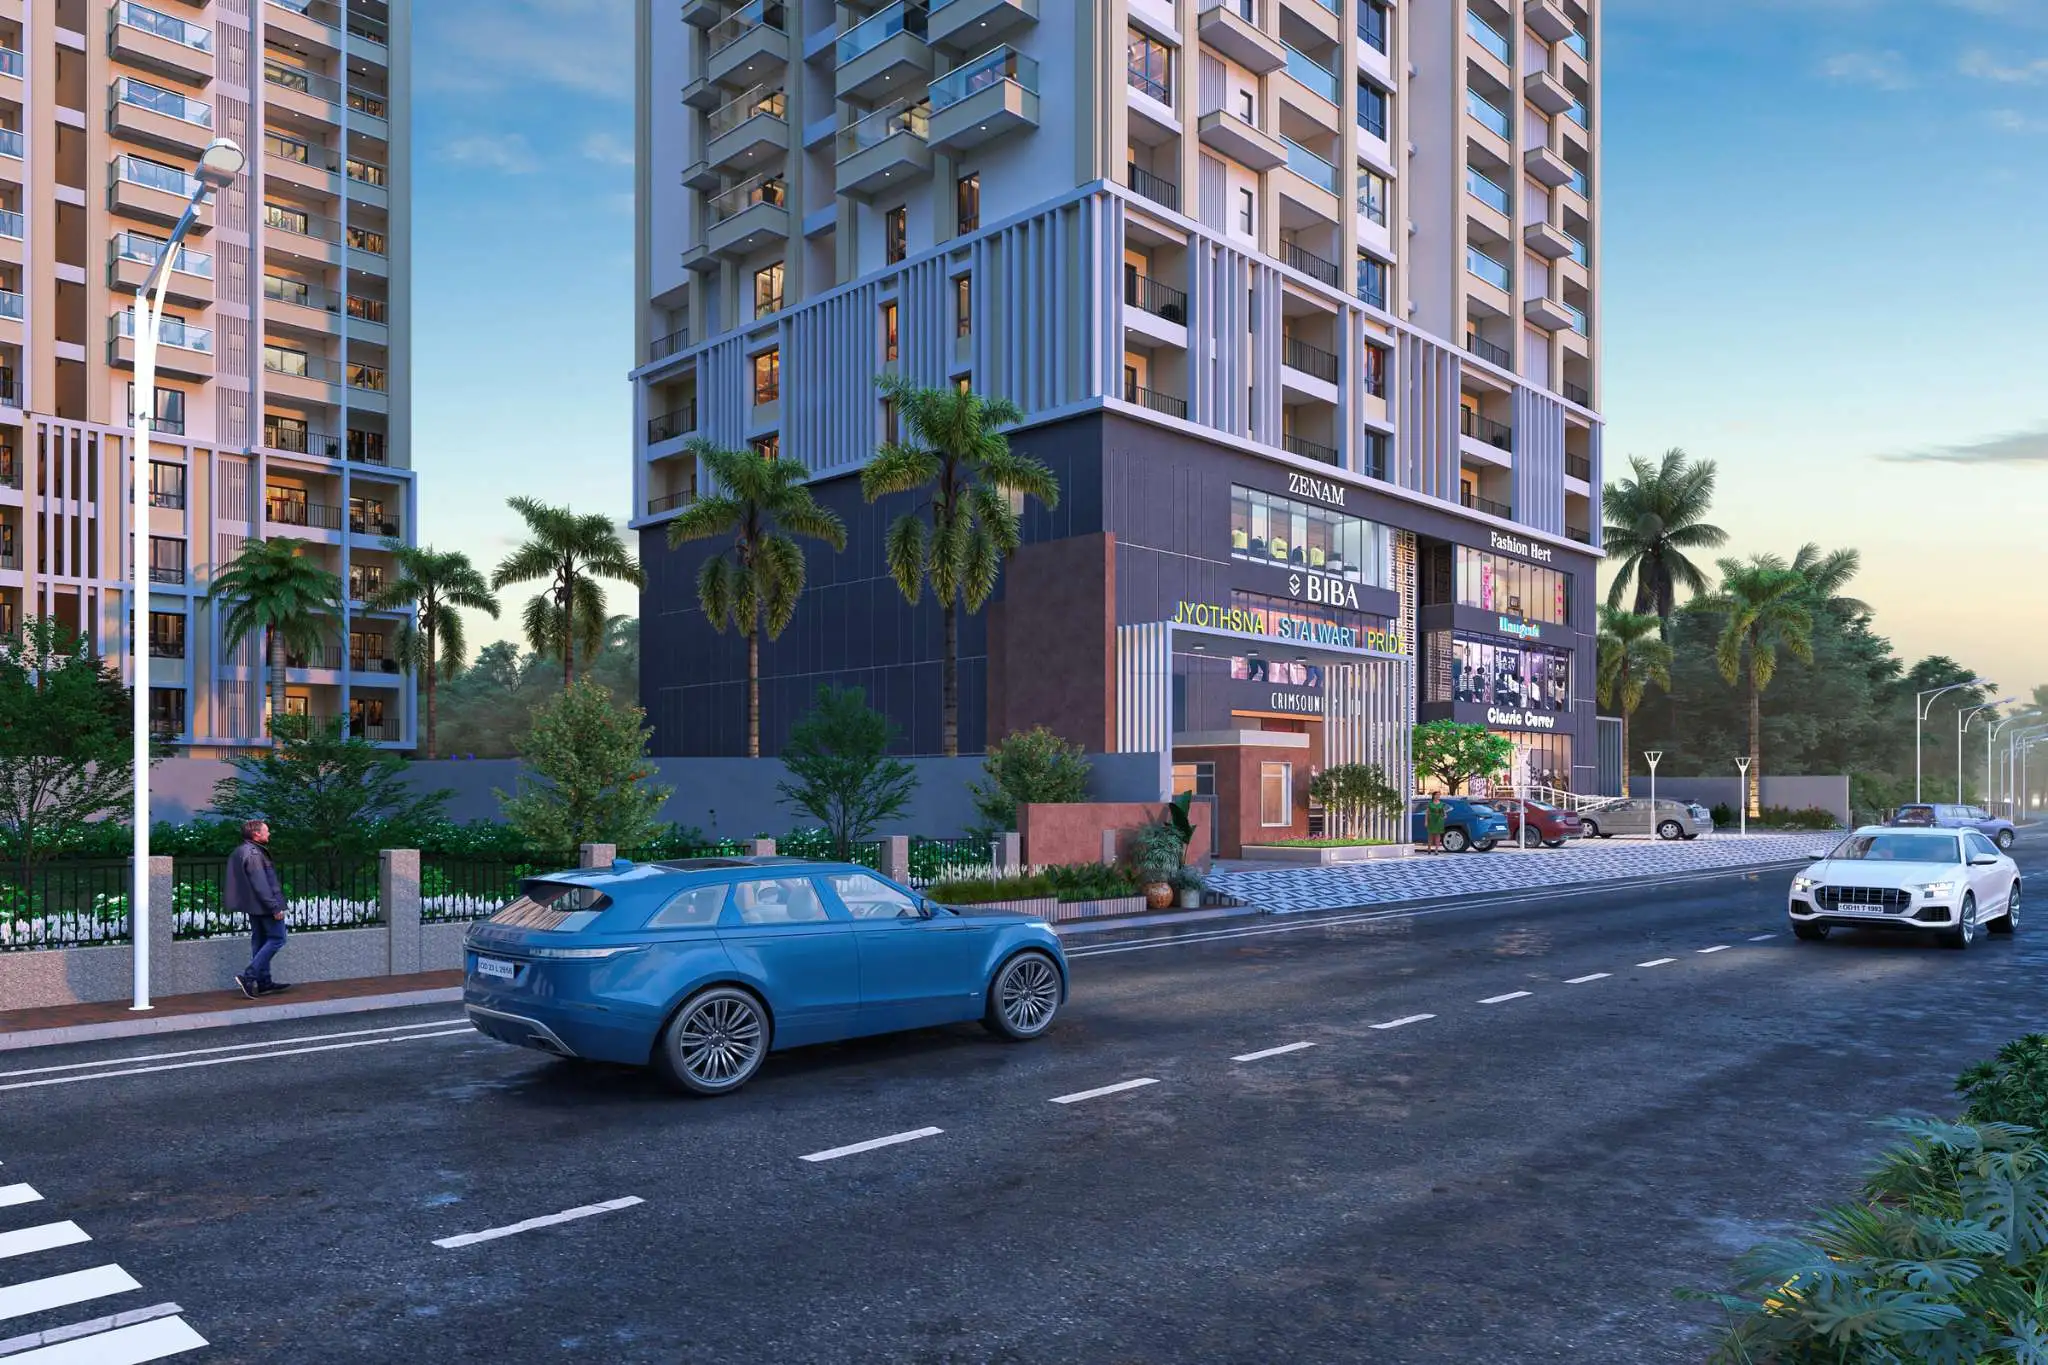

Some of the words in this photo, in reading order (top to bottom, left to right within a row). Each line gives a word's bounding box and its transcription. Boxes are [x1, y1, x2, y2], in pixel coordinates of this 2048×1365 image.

[1289, 472, 1345, 507] ZENAM
[1490, 531, 1528, 556] Fashion
[1530, 542, 1552, 562] Hert
[1307, 574, 1359, 609] BIBA
[1174, 600, 1265, 635] JYOTHSNA
[1279, 617, 1359, 648] STALWART
[1367, 631, 1405, 655] PRIDE
[1487, 706, 1522, 726] Classic
